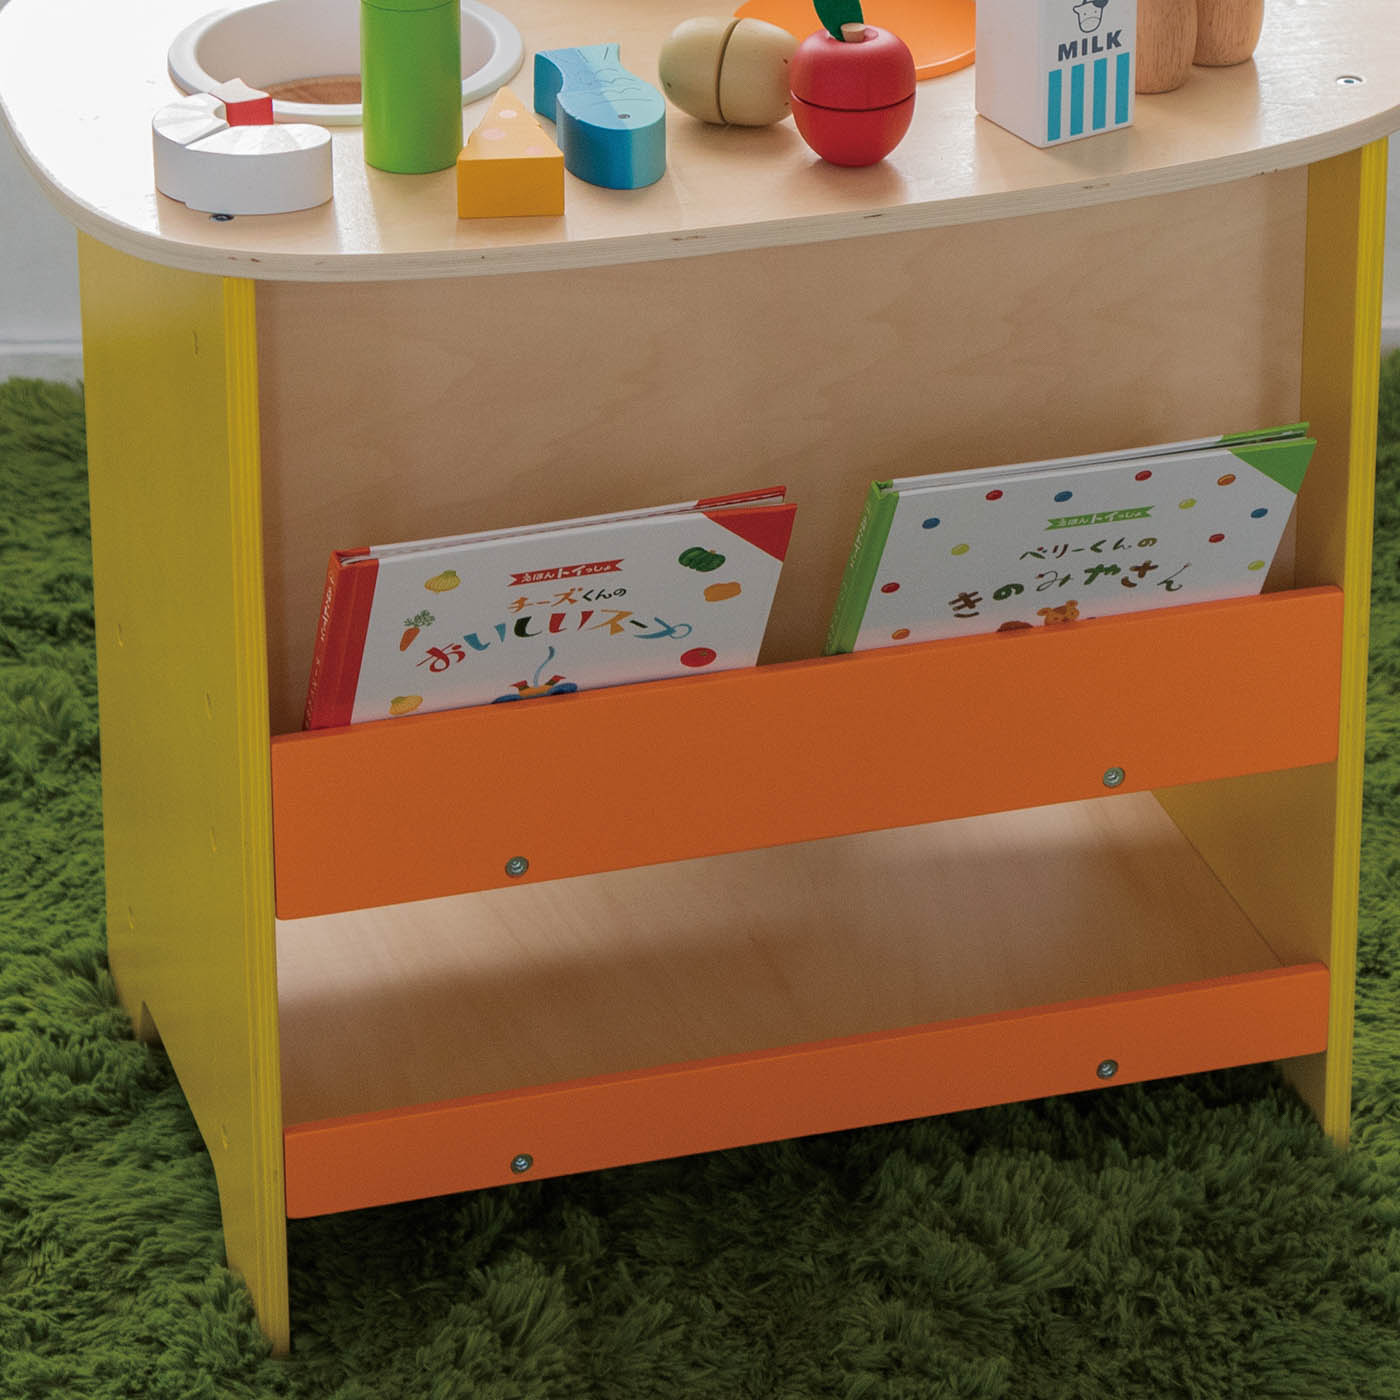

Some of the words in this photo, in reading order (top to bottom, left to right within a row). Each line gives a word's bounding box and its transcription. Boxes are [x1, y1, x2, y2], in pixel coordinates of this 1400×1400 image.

[1057, 29, 1123, 62] MILK
[1019, 537, 1158, 560] ベリーくんの
[507, 587, 627, 614] チーズくんの
[948, 560, 1192, 618] きのみやさん
[416, 610, 692, 672] おいしいスープ
